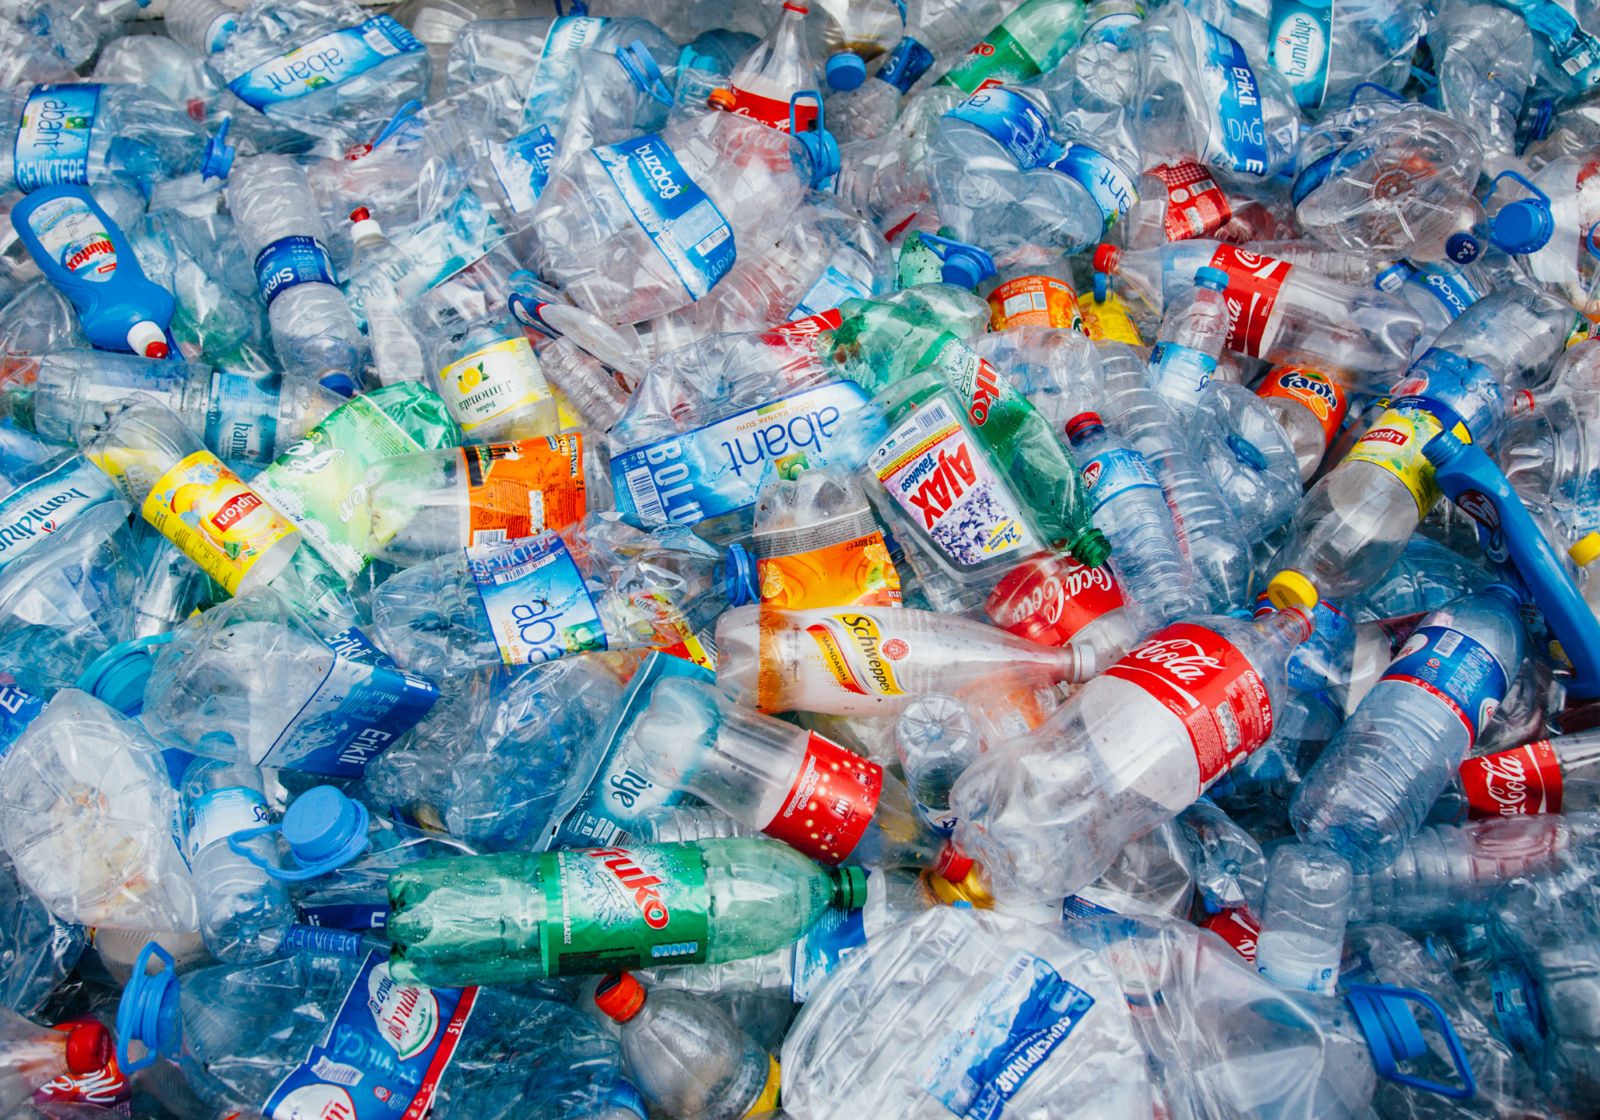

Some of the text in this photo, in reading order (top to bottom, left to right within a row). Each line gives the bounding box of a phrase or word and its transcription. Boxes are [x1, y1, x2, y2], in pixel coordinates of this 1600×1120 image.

[264, 47, 342, 93] abant
[1286, 17, 1317, 79] hamidiye
[1231, 67, 1258, 108] Erikli
[33, 99, 69, 150] abant
[66, 240, 115, 272] Mintax
[458, 380, 513, 410] Limonata
[1279, 372, 1337, 411] Fanta
[721, 404, 840, 477] abant
[1360, 429, 1409, 444] Lipton
[649, 440, 704, 528] BOLU
[901, 449, 937, 492] Fabuloso
[908, 441, 977, 530] AJAX
[216, 492, 262, 528] Lipton
[821, 635, 848, 682] MANDARIN
[842, 614, 892, 694] Schweppes
[338, 726, 392, 765] Erikli
